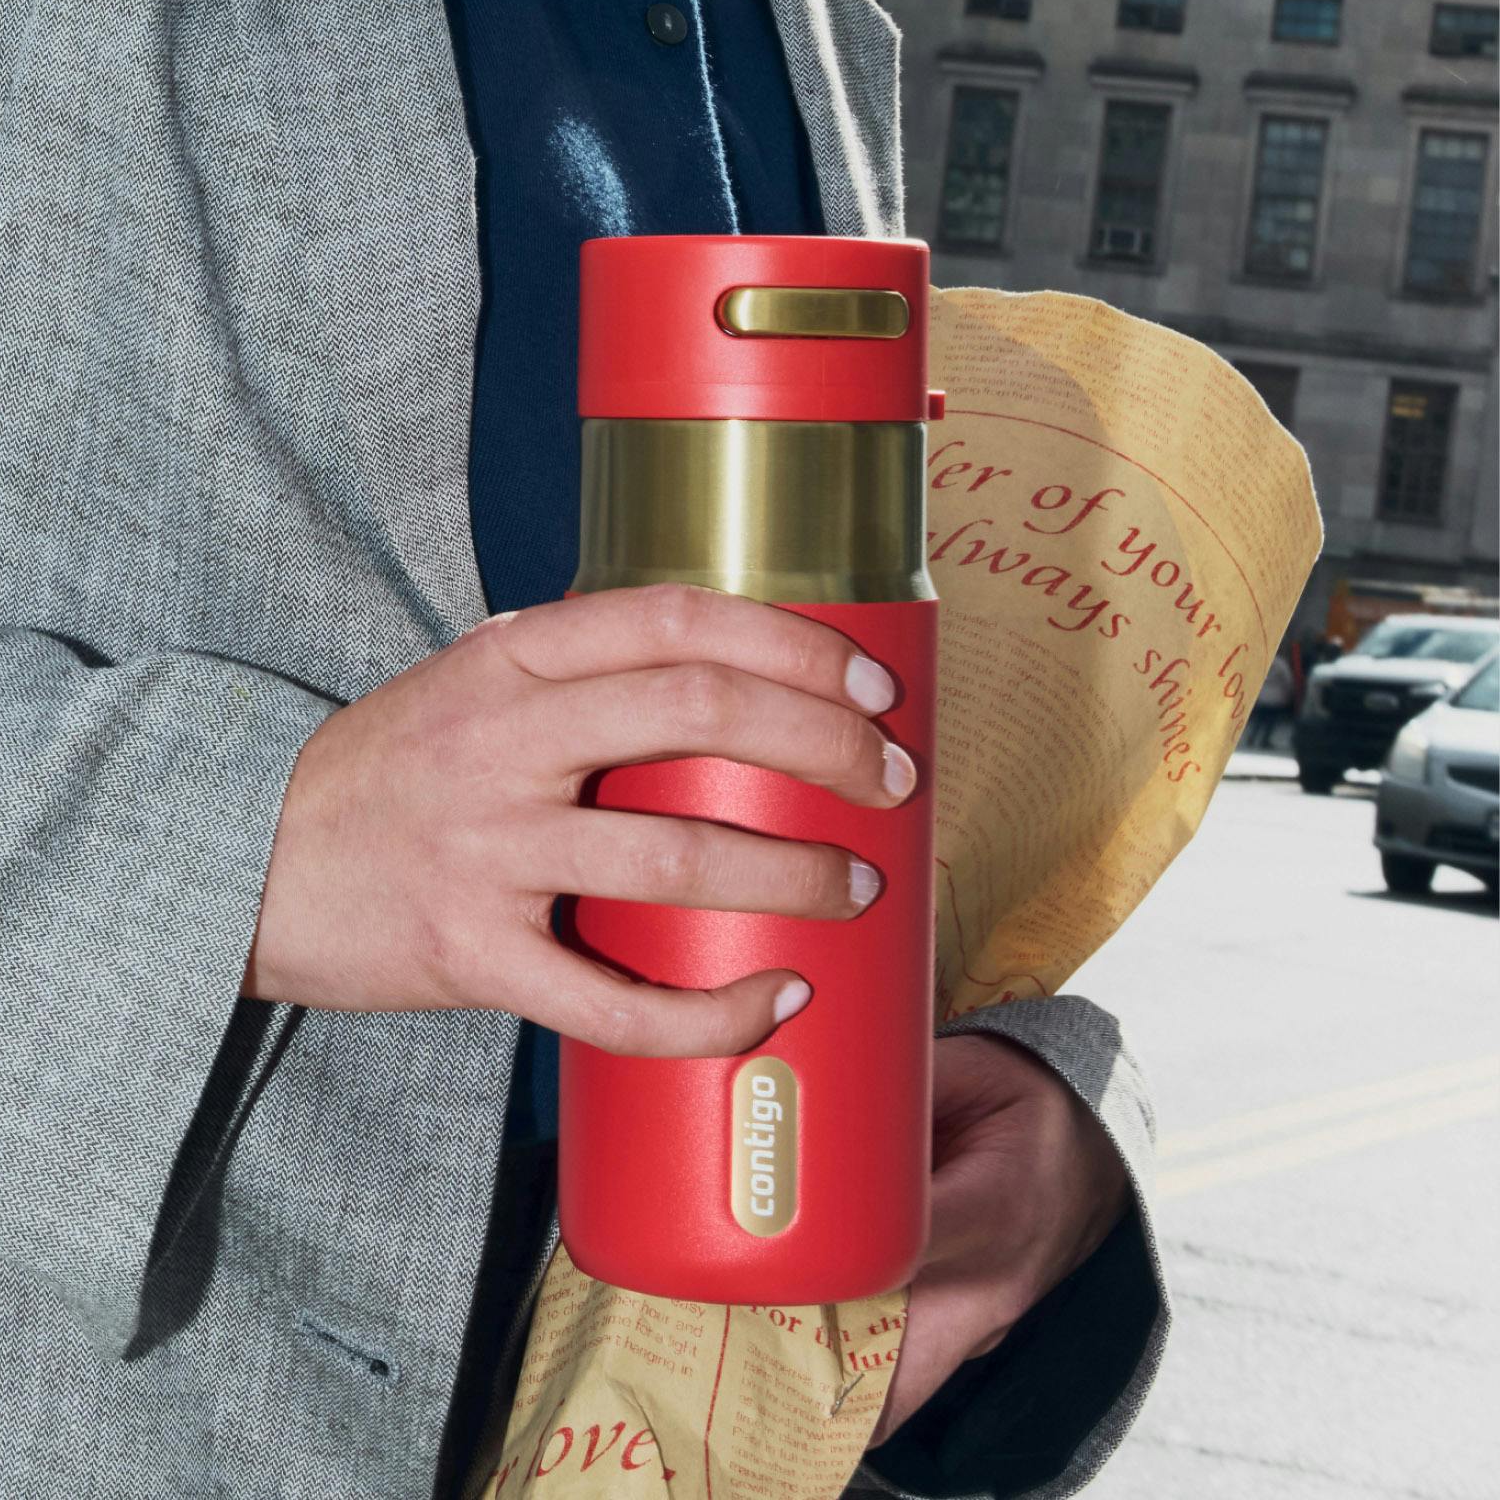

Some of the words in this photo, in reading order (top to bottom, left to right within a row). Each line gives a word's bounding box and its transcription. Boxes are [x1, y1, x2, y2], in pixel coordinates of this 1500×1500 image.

[1023, 484, 1126, 535] of
[1101, 527, 1222, 638] your
[1133, 648, 1202, 782] shines
[744, 1075, 782, 1217] contigo
[676, 1320, 705, 1338] and
